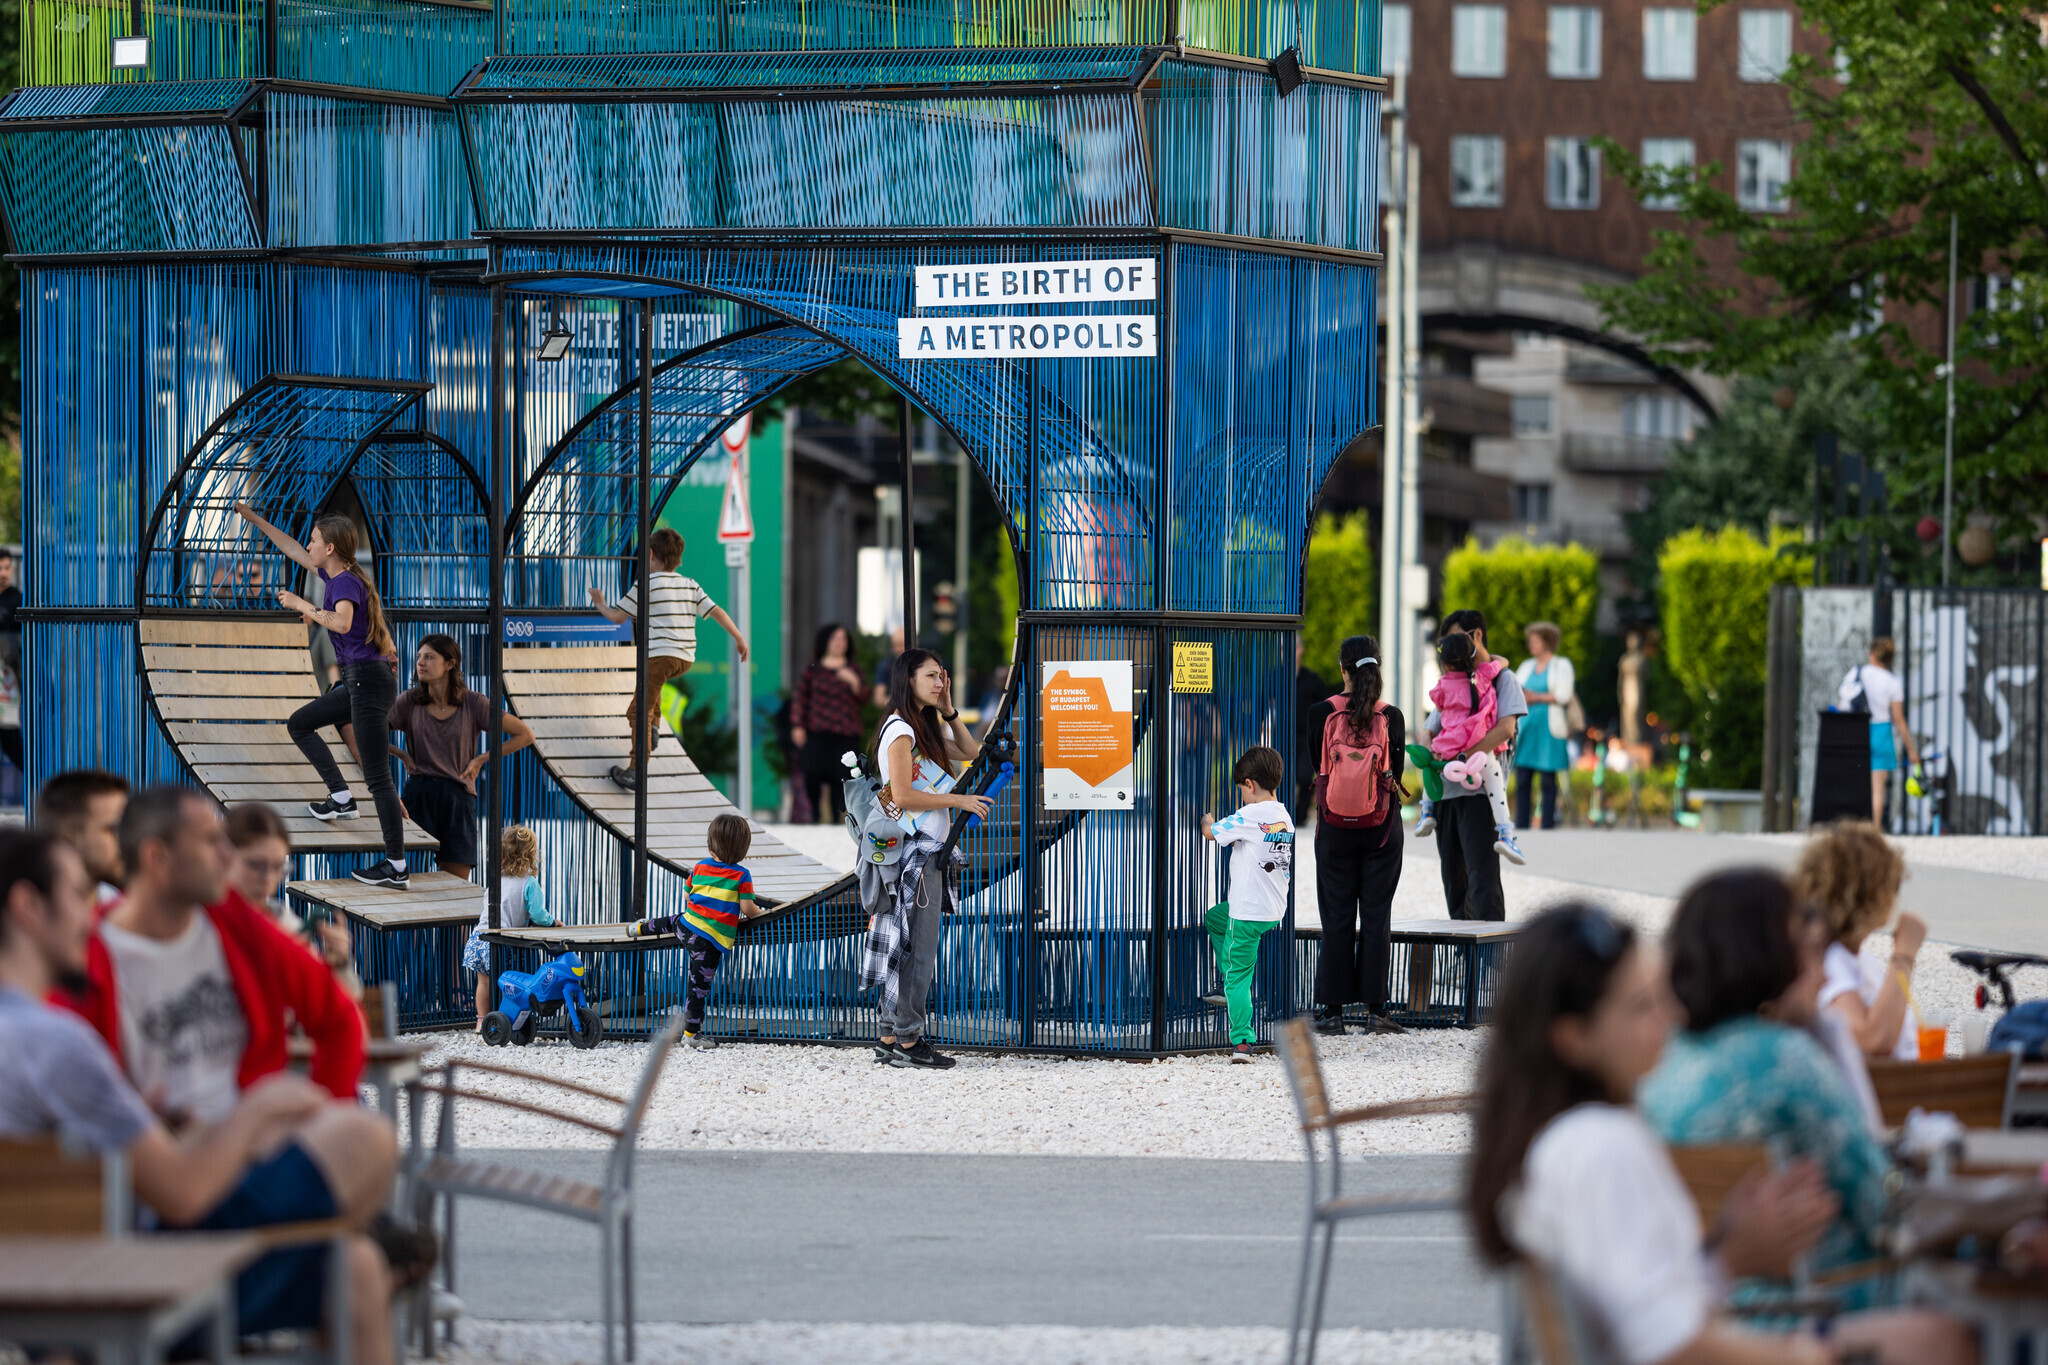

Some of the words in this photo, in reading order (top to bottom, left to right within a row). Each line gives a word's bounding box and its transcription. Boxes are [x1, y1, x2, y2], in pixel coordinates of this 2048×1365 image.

[932, 271, 990, 299] THE
[1002, 267, 1092, 297] BIRTH
[1104, 266, 1143, 293] OF
[917, 325, 936, 351] A
[946, 322, 1144, 351] METROPOLIS
[1264, 832, 1294, 843] INFINIT
